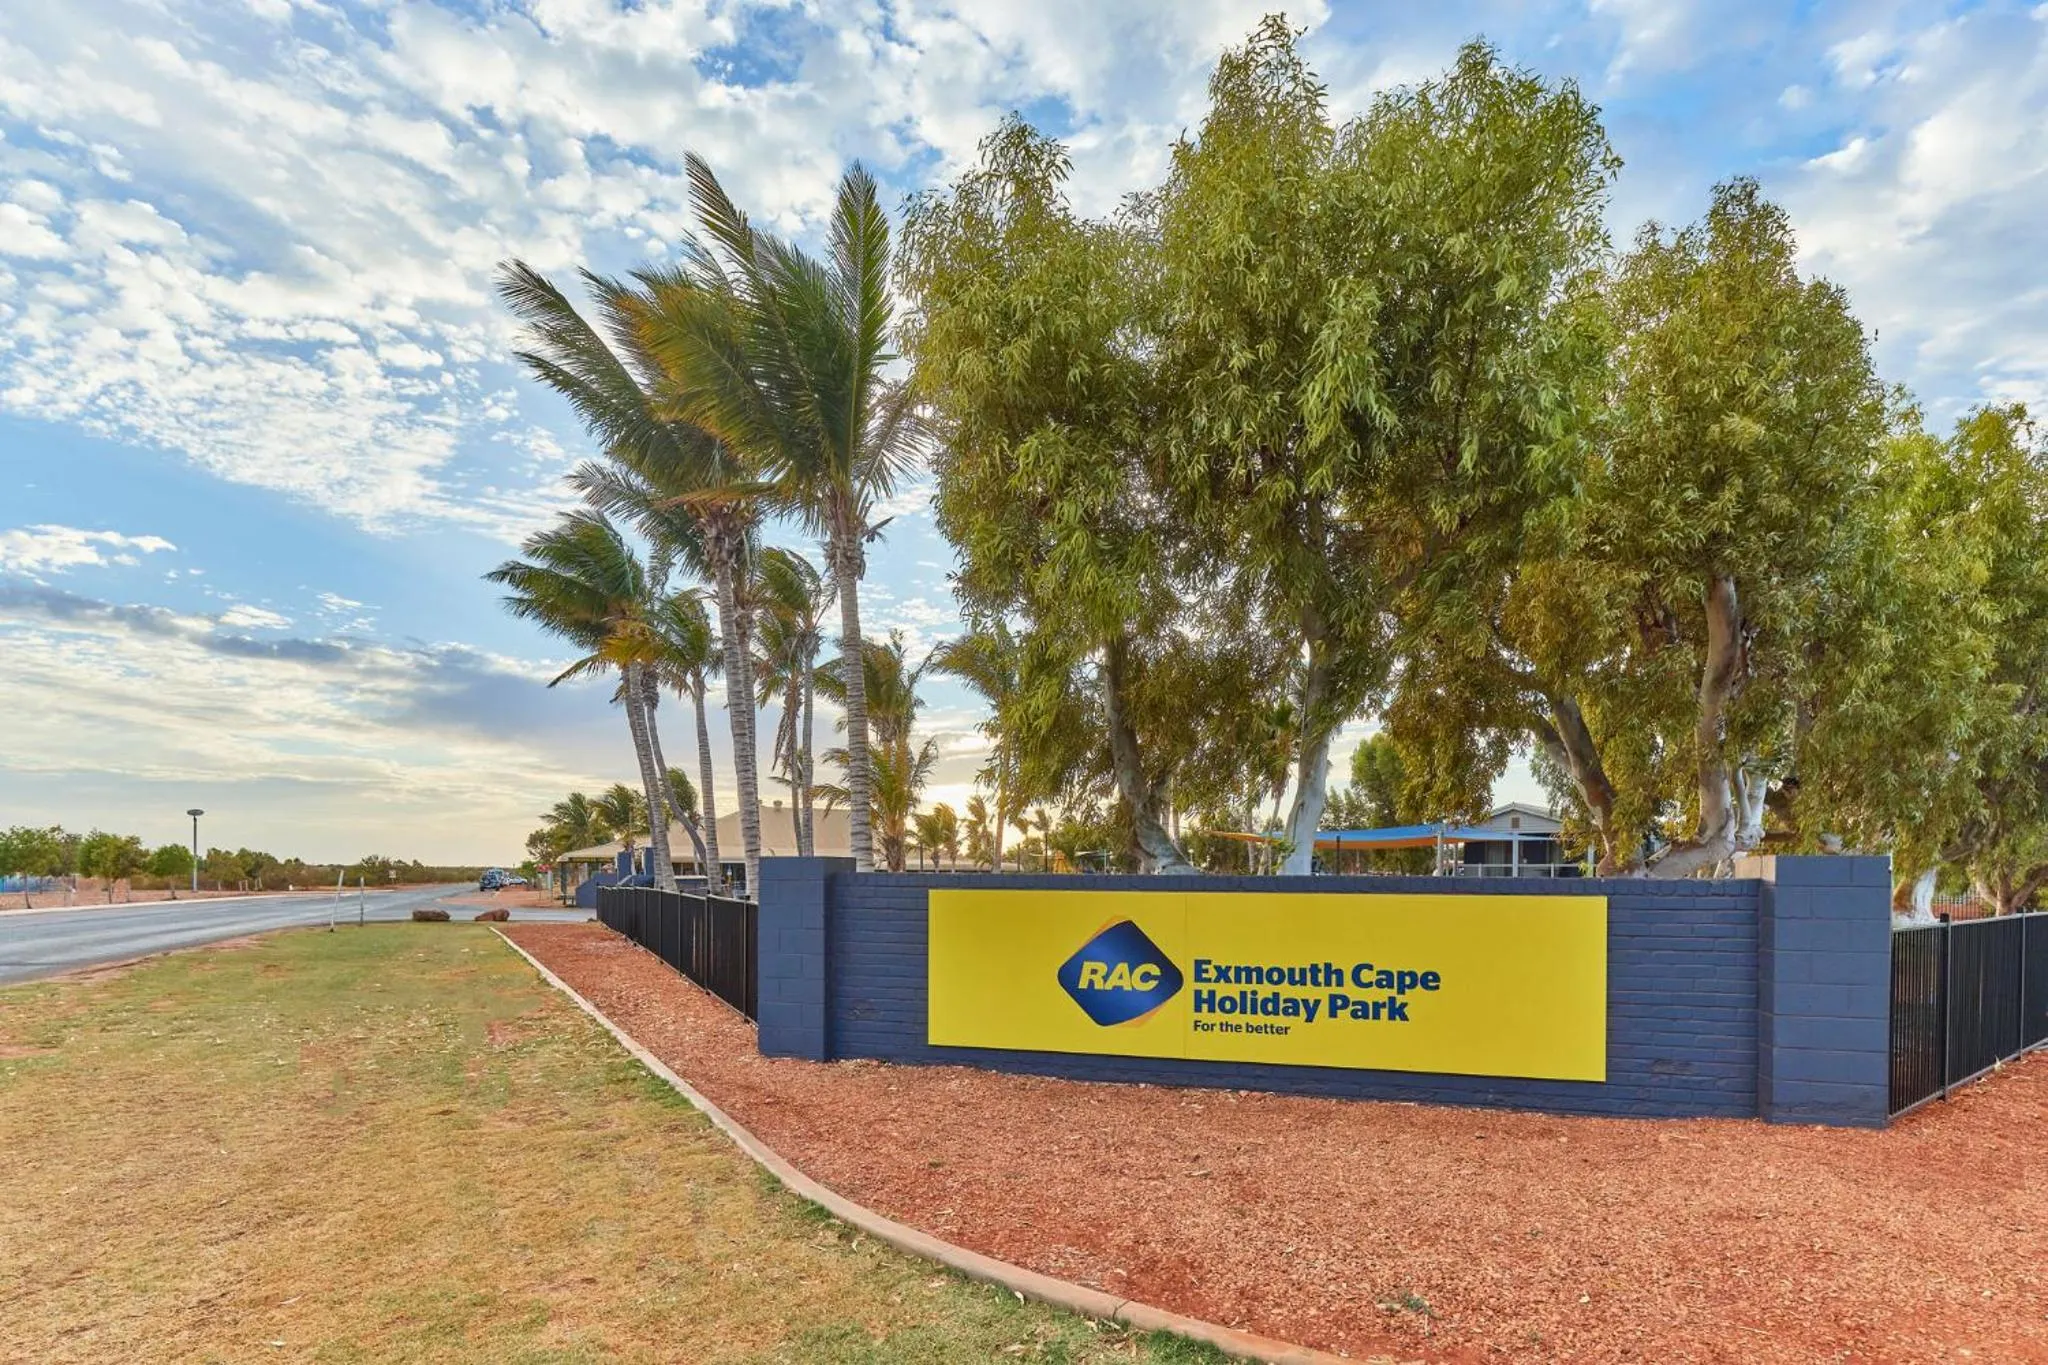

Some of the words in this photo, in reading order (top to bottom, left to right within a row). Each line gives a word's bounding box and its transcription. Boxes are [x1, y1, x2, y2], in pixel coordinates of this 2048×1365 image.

[1078, 961, 1162, 992] RAC
[1193, 959, 1344, 988] Exmouth
[1351, 963, 1441, 995] Cape
[1193, 990, 1322, 1023] Holiday
[1328, 994, 1410, 1021] Park
[1193, 1020, 1217, 1032] For
[1219, 1021, 1242, 1033] the
[1245, 1022, 1291, 1035] better
